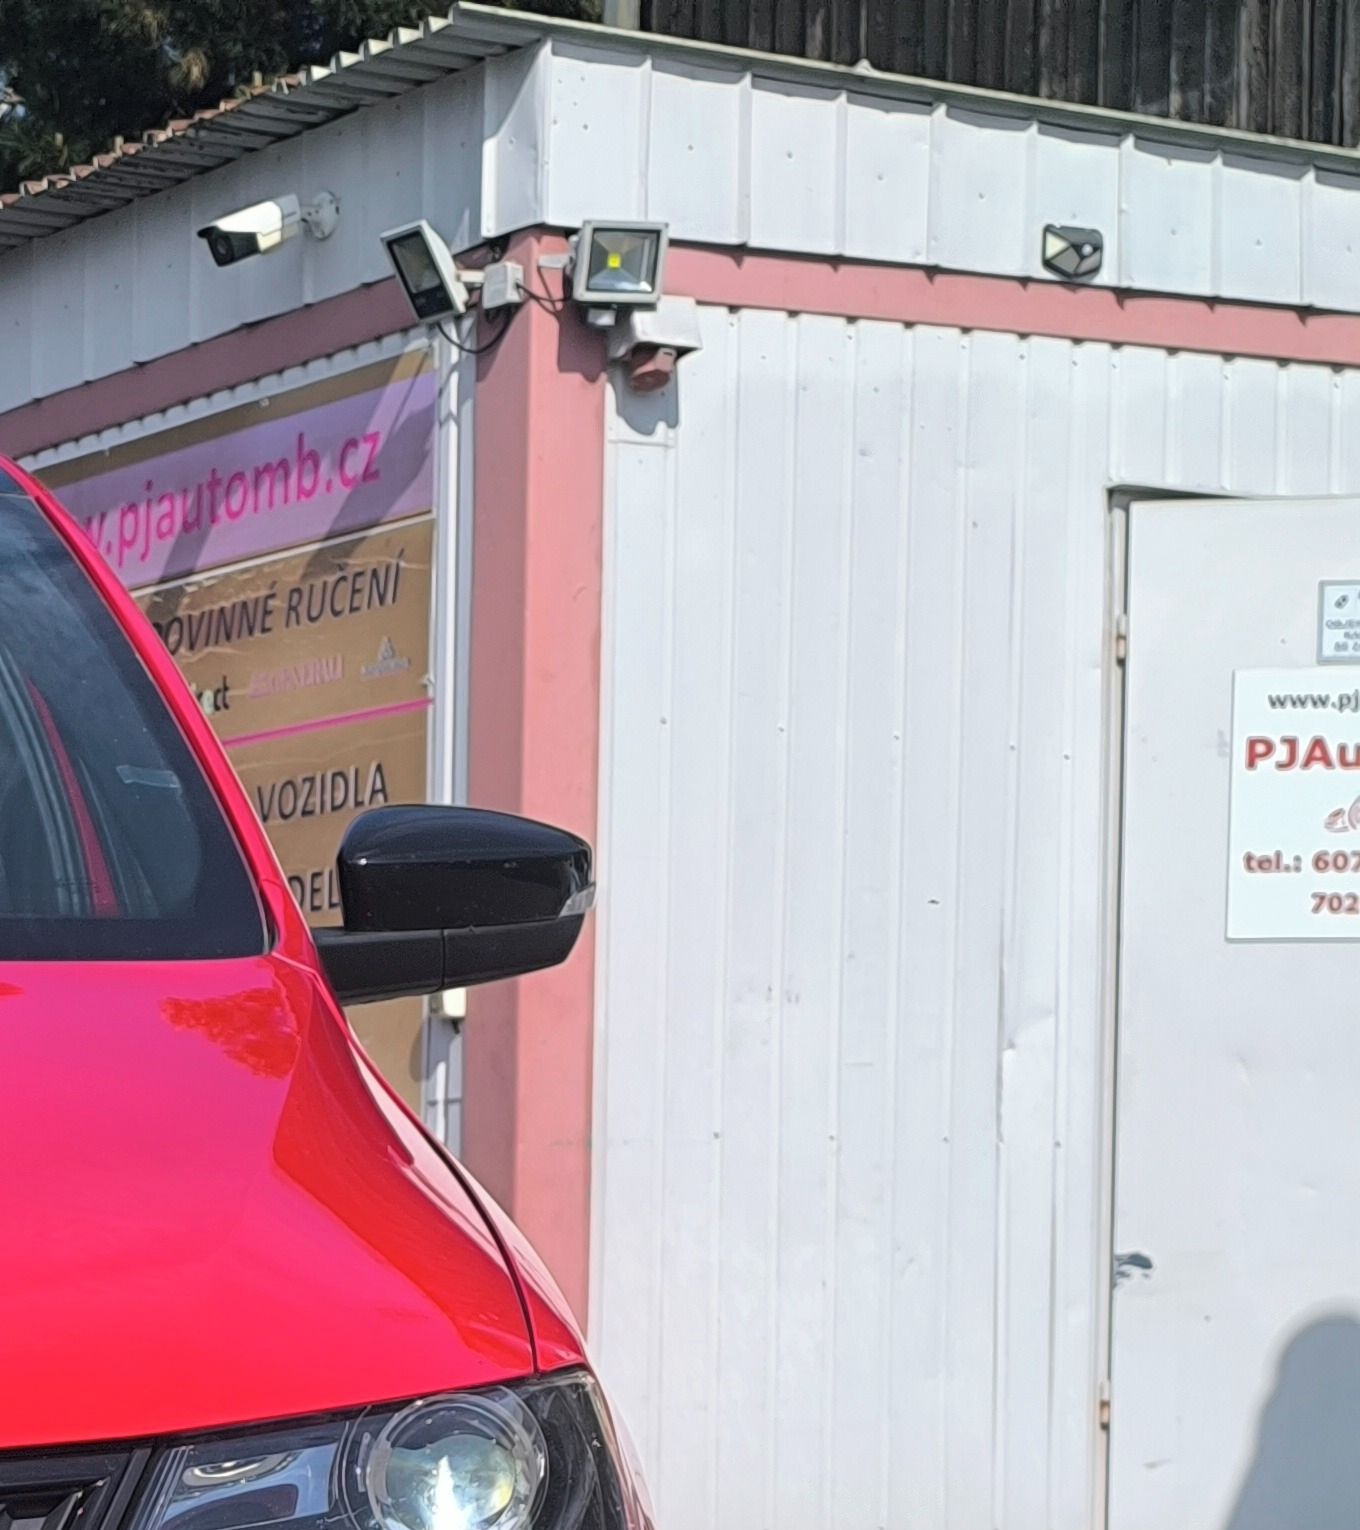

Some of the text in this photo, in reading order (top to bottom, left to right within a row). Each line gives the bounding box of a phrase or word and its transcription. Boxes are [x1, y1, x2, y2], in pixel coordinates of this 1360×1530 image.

[285, 548, 404, 628] RUČENÍ
[257, 762, 388, 822] VOZIDLA
[1243, 849, 1302, 873] tel.:
[1310, 891, 1360, 914] 702
